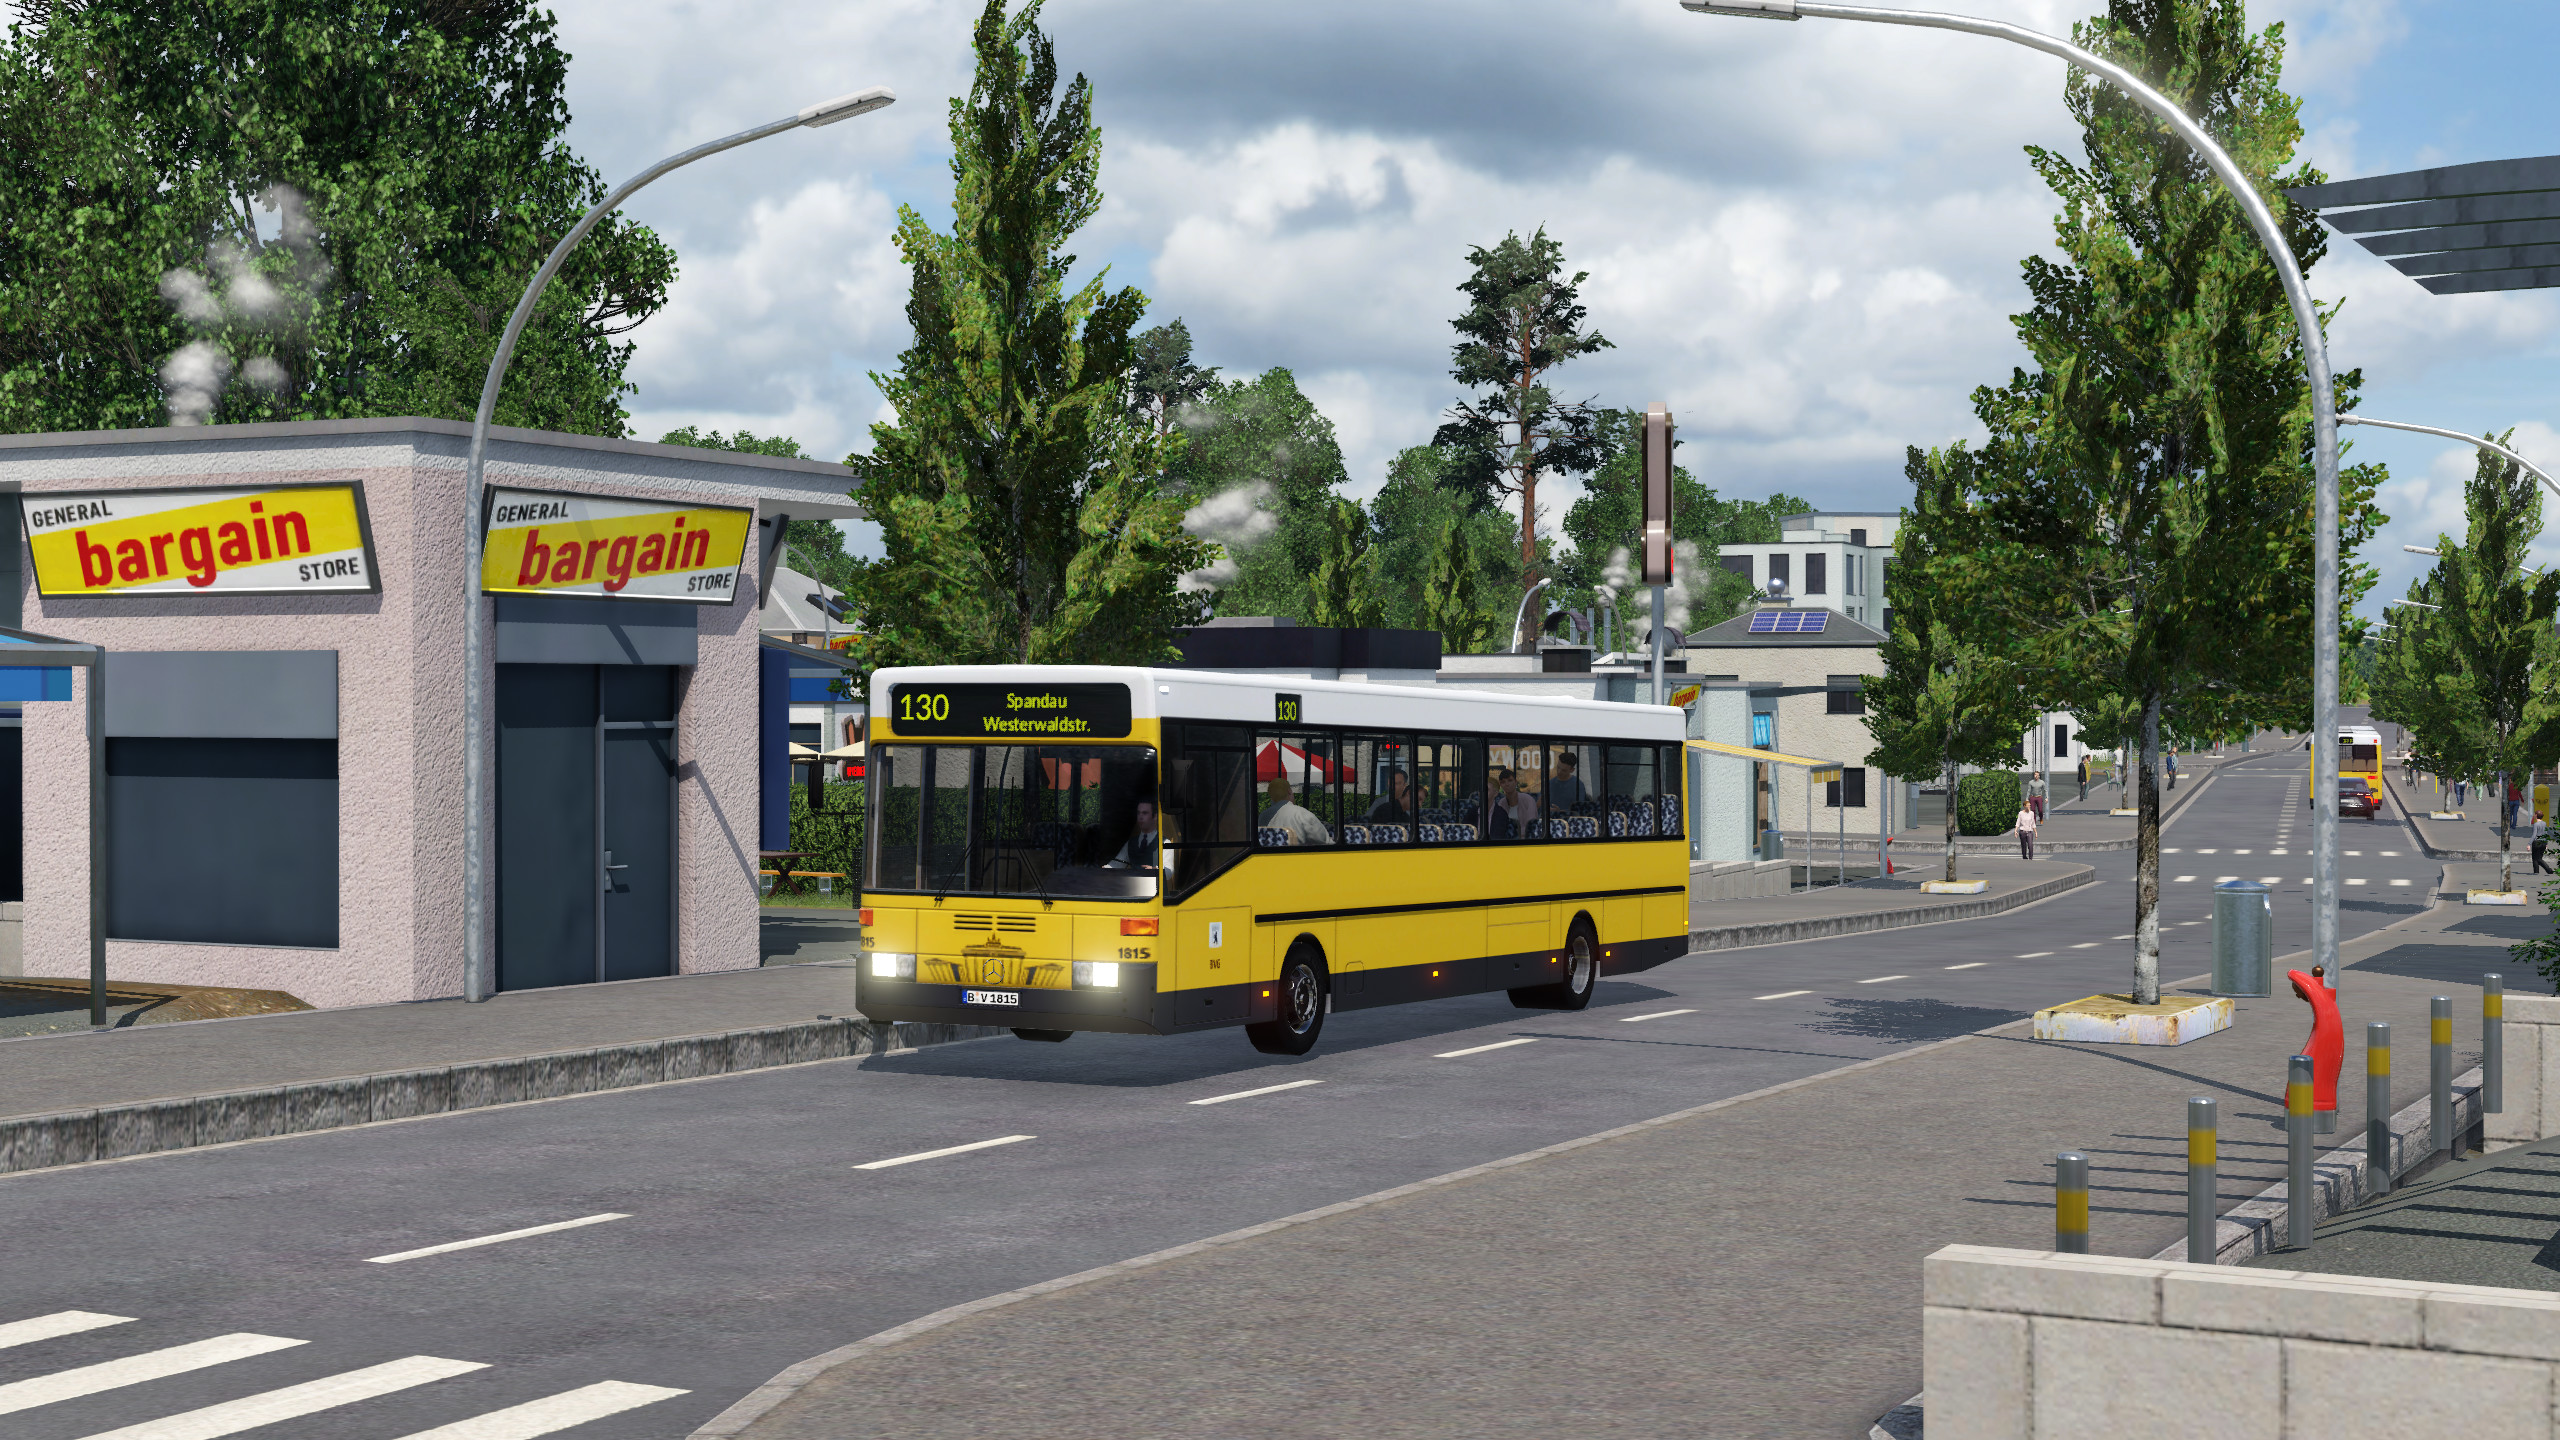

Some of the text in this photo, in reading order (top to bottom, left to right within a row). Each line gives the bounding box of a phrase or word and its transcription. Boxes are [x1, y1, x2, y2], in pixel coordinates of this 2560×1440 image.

[32, 500, 113, 528] GENERAL
[496, 501, 569, 523] GENERAL
[75, 500, 312, 588] bargain
[517, 516, 711, 593] bargain
[299, 557, 360, 582] STORE
[687, 573, 733, 593] STORE
[900, 693, 950, 721] 130
[1006, 692, 1068, 712] Spandau
[1277, 700, 1297, 721] 130
[982, 715, 1091, 733] Westerwaldstr.
[1118, 947, 1151, 959] 1815
[967, 992, 1017, 1004] B V 1815
